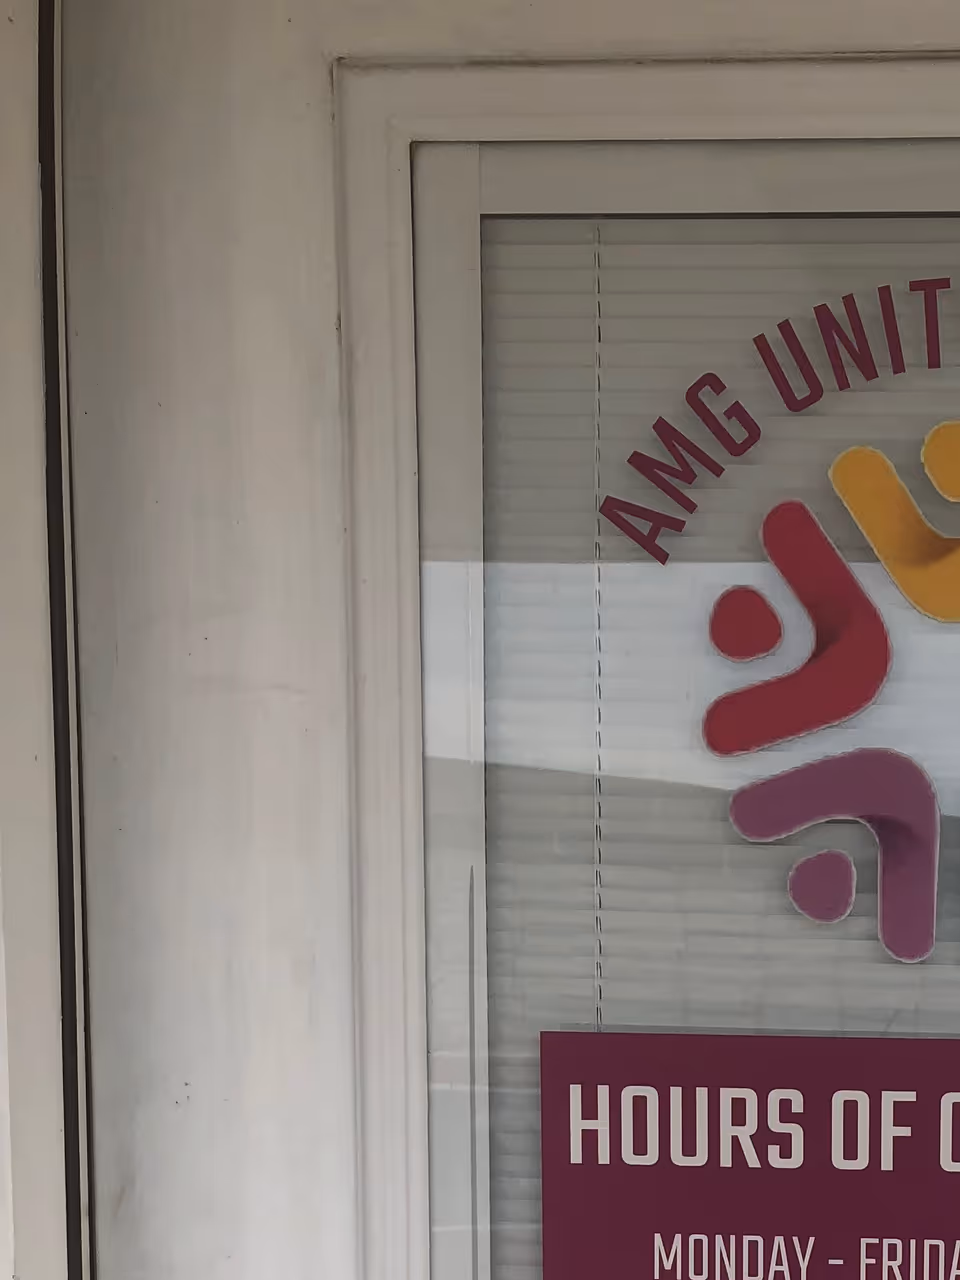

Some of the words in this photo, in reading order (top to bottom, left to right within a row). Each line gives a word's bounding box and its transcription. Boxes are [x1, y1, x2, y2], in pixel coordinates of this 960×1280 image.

[600, 373, 761, 565] AMG
[568, 1084, 804, 1169] HOURS
[831, 1089, 918, 1172] OF
